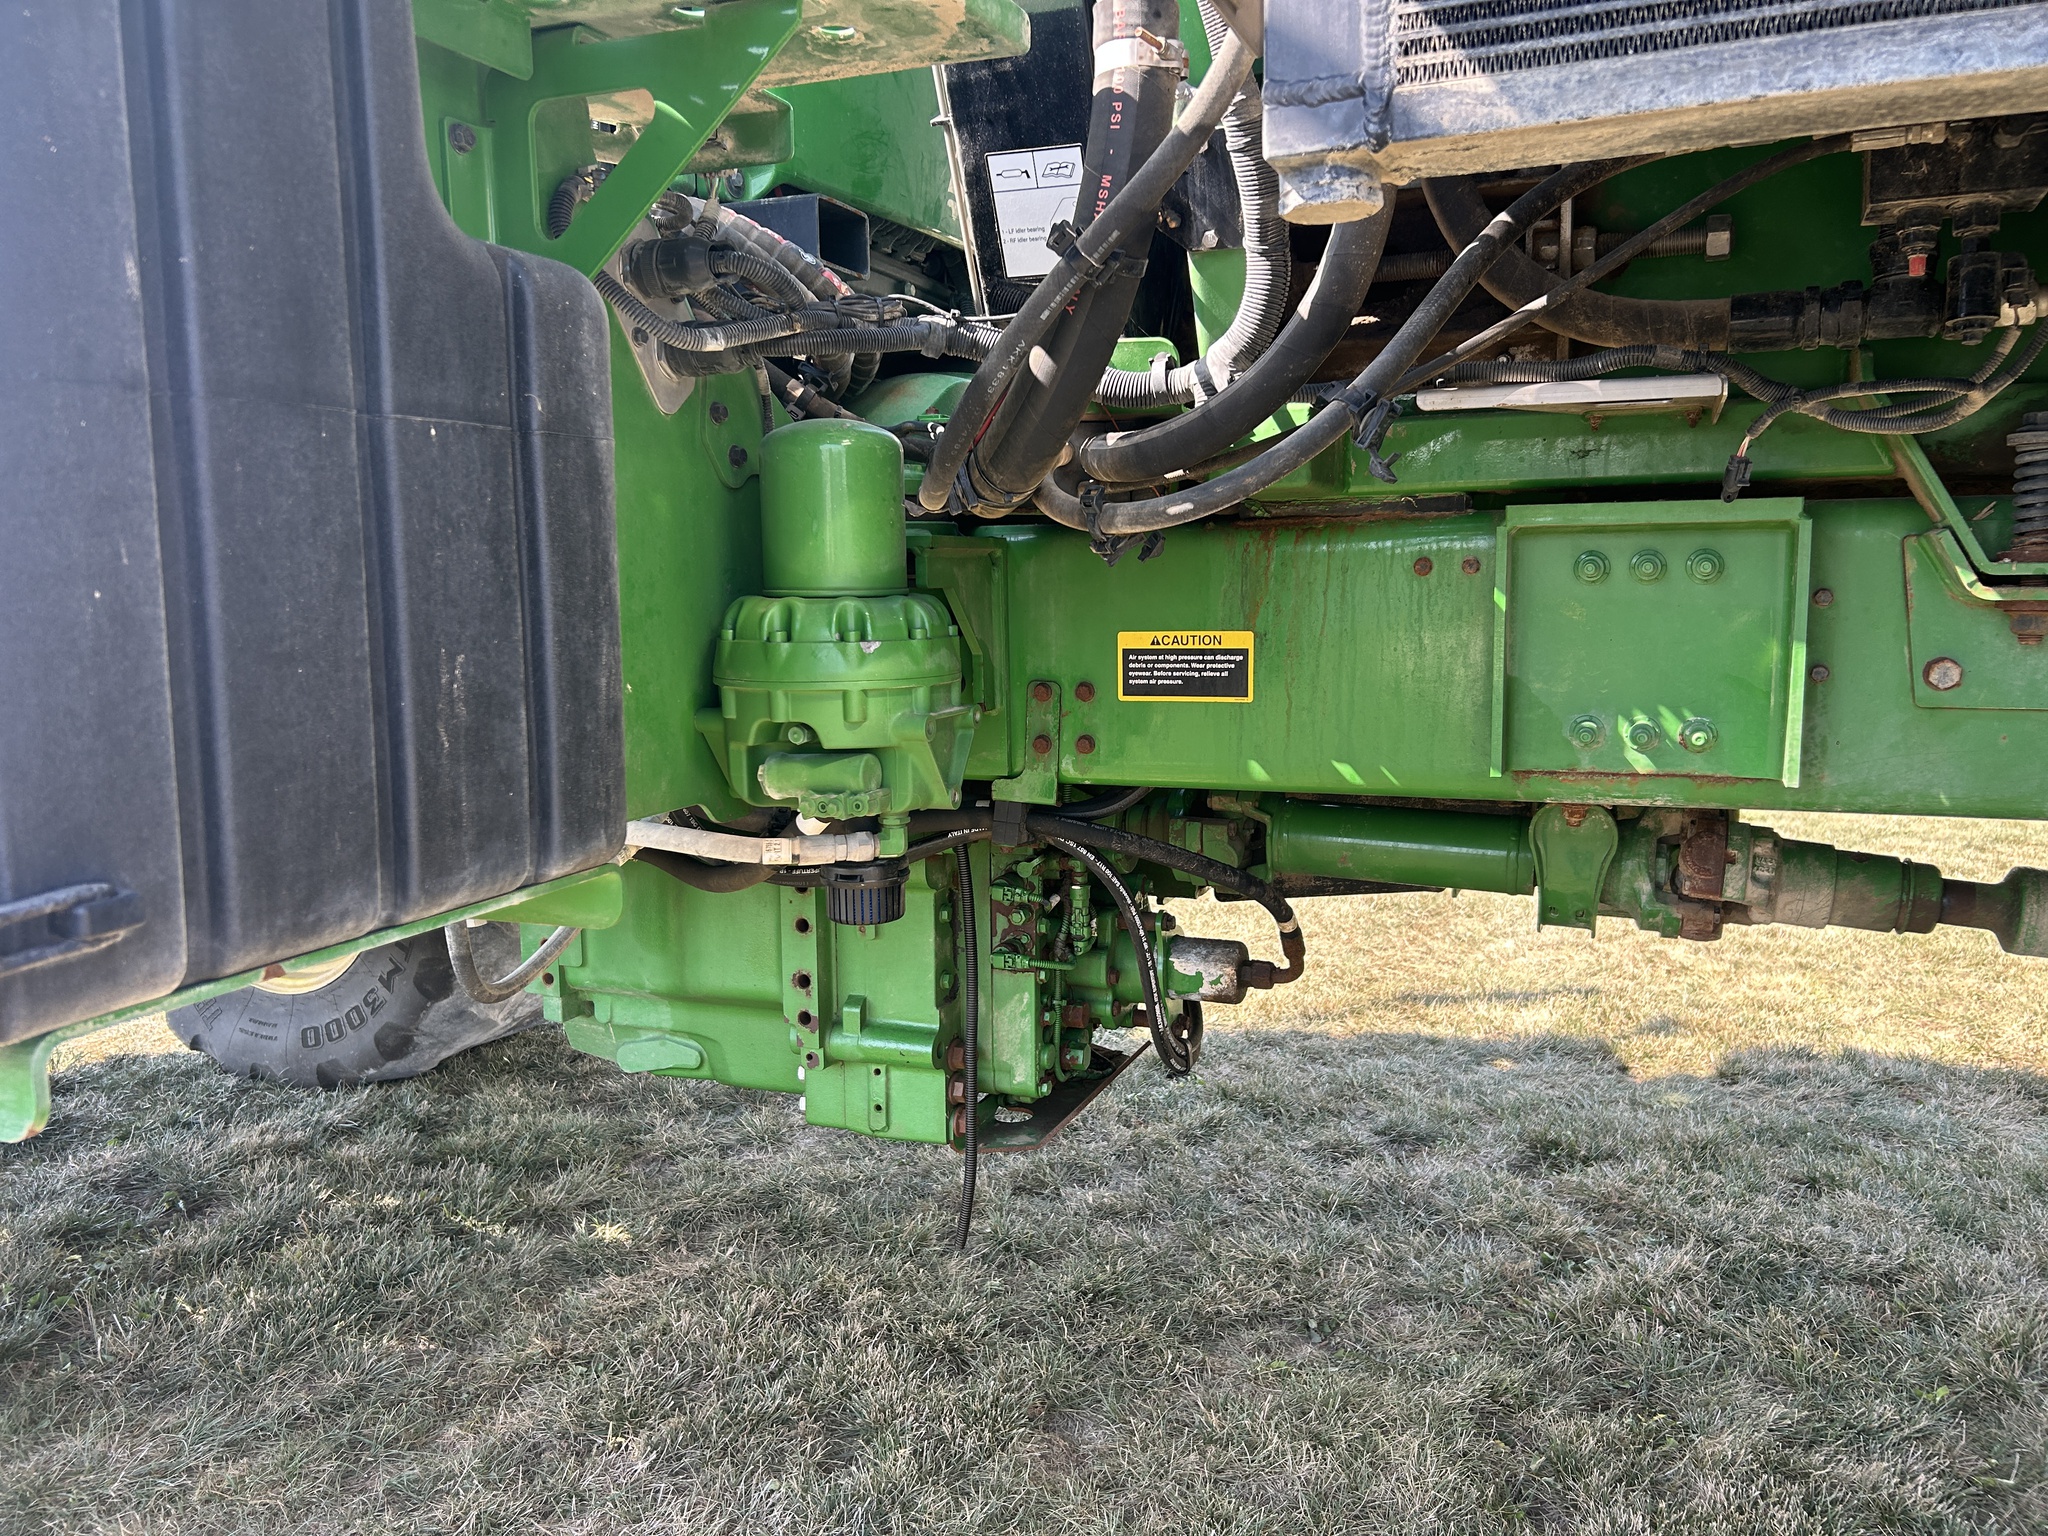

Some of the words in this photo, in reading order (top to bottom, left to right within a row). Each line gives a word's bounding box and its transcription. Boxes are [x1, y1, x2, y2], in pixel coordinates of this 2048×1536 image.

[1110, 101, 1123, 129] PSI
[1161, 635, 1222, 646] CAUTION
[947, 830, 963, 838] ITALY
[1086, 851, 1095, 861] EN
[1096, 861, 1107, 871] R17
[1105, 868, 1113, 878] 100
[1111, 876, 1121, 887] SAE
